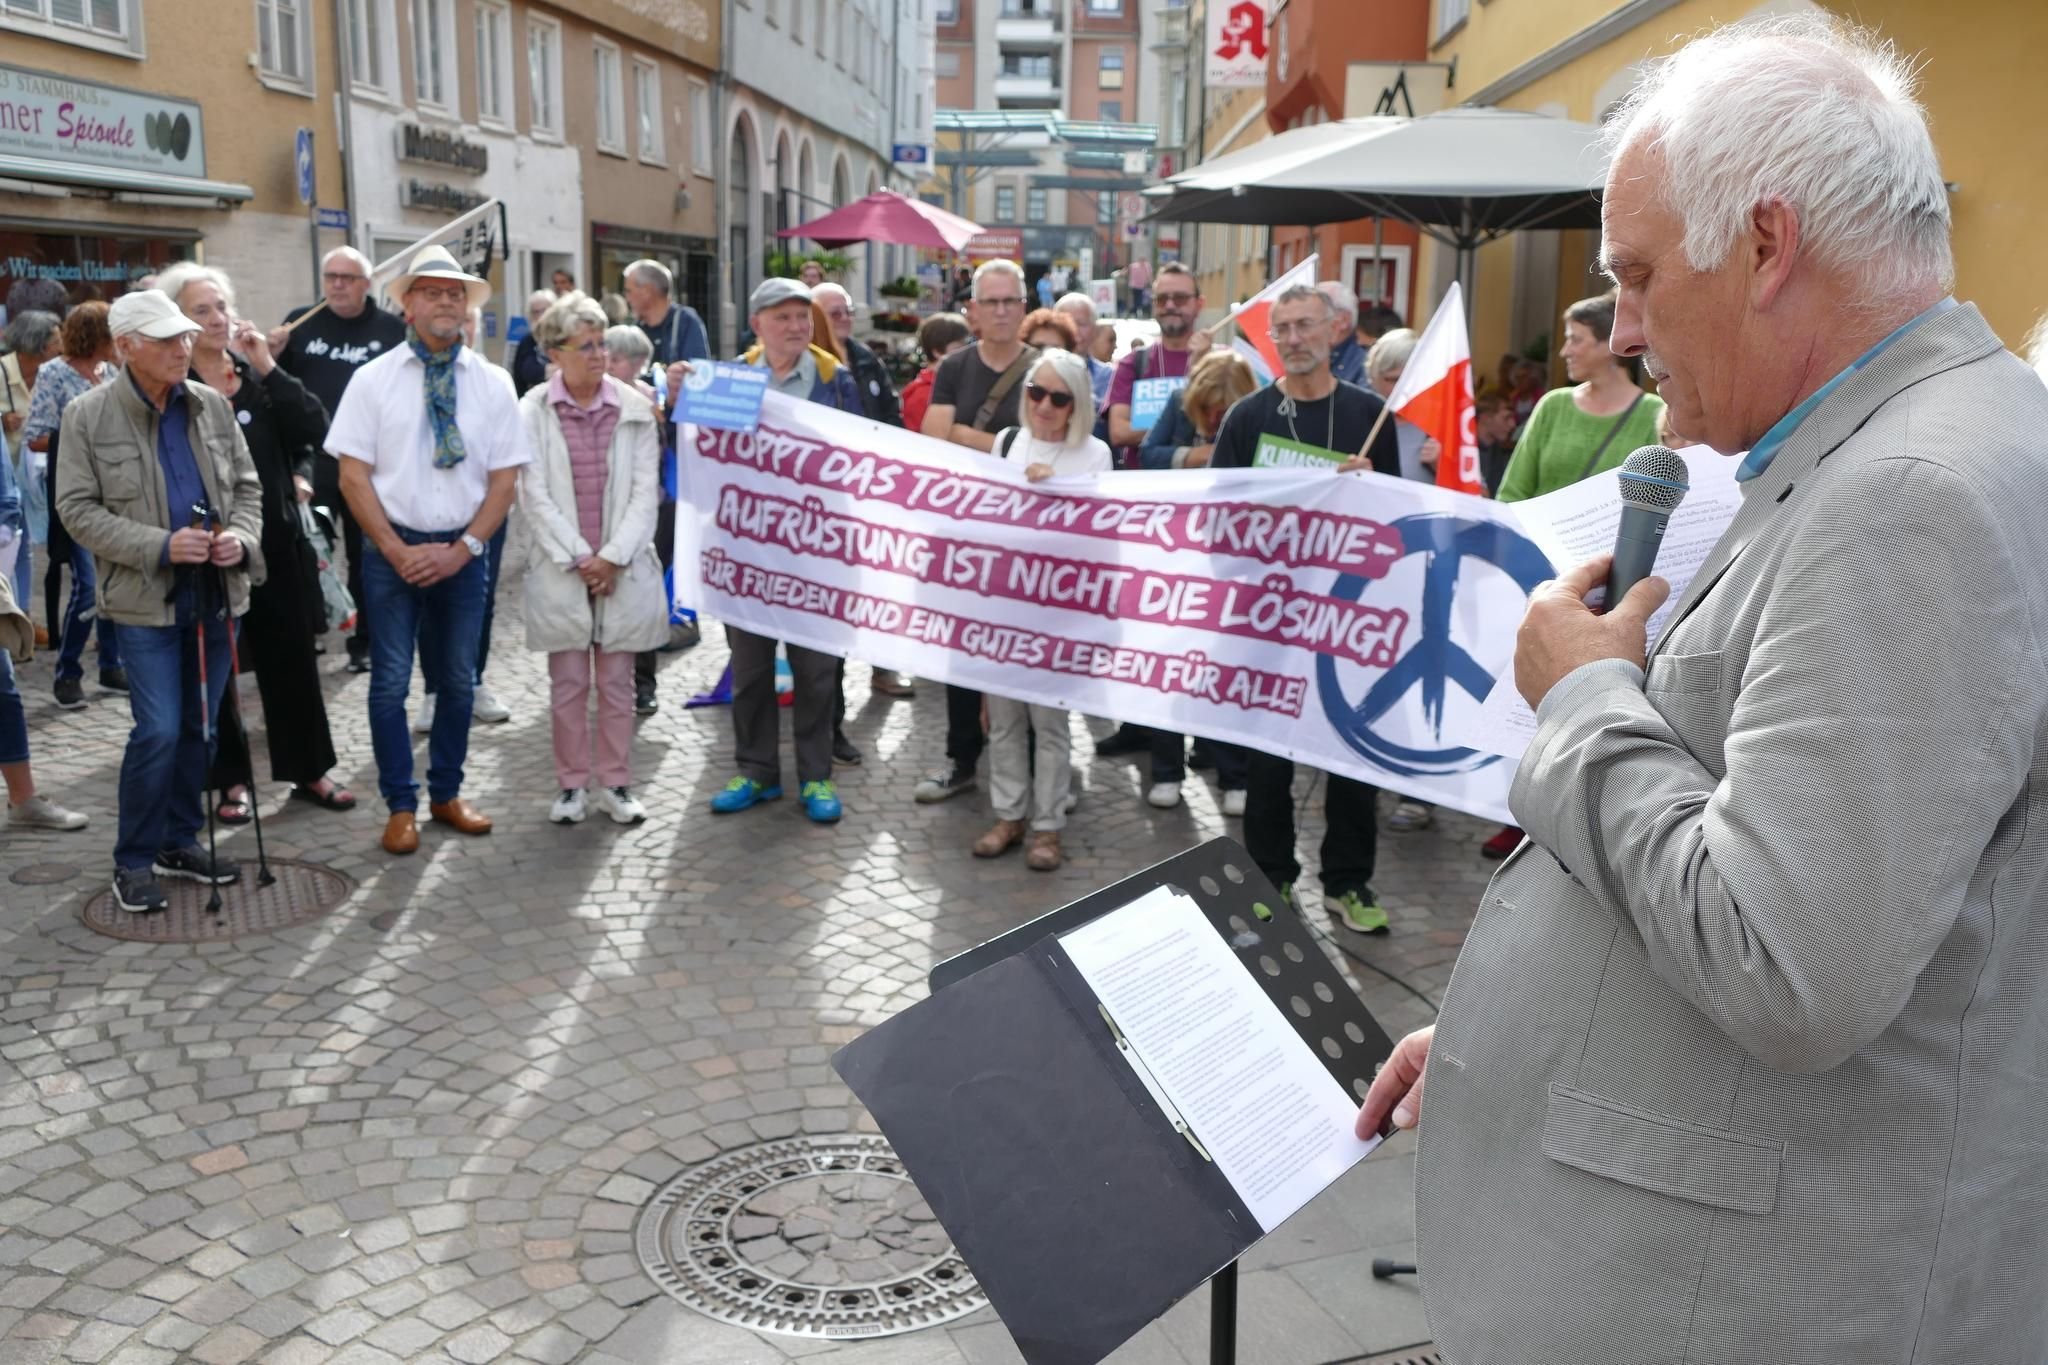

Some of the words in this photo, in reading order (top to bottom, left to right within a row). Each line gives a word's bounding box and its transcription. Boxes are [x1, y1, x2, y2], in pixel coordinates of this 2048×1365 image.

[698, 427, 822, 474] STOPPT
[818, 455, 898, 496] DAS
[906, 471, 1034, 517] TÖTEN
[1037, 499, 1089, 528] IN
[1090, 503, 1176, 548] DER
[702, 549, 736, 592] FÜR
[740, 568, 839, 616] FRIEDEN
[844, 597, 901, 631] UND
[906, 613, 955, 644] EIN
[961, 623, 1044, 663] GUTES
[1051, 638, 1156, 684] LEBEN
[1162, 652, 1223, 699] FÜR
[1226, 671, 1306, 717] ALLE!
[718, 489, 934, 579] AUFRÜSTUNG
[943, 543, 999, 591] IST
[1007, 559, 1131, 614] NICHT
[1138, 576, 1208, 620] DIE
[1219, 578, 1402, 662] LÖSUNG!
